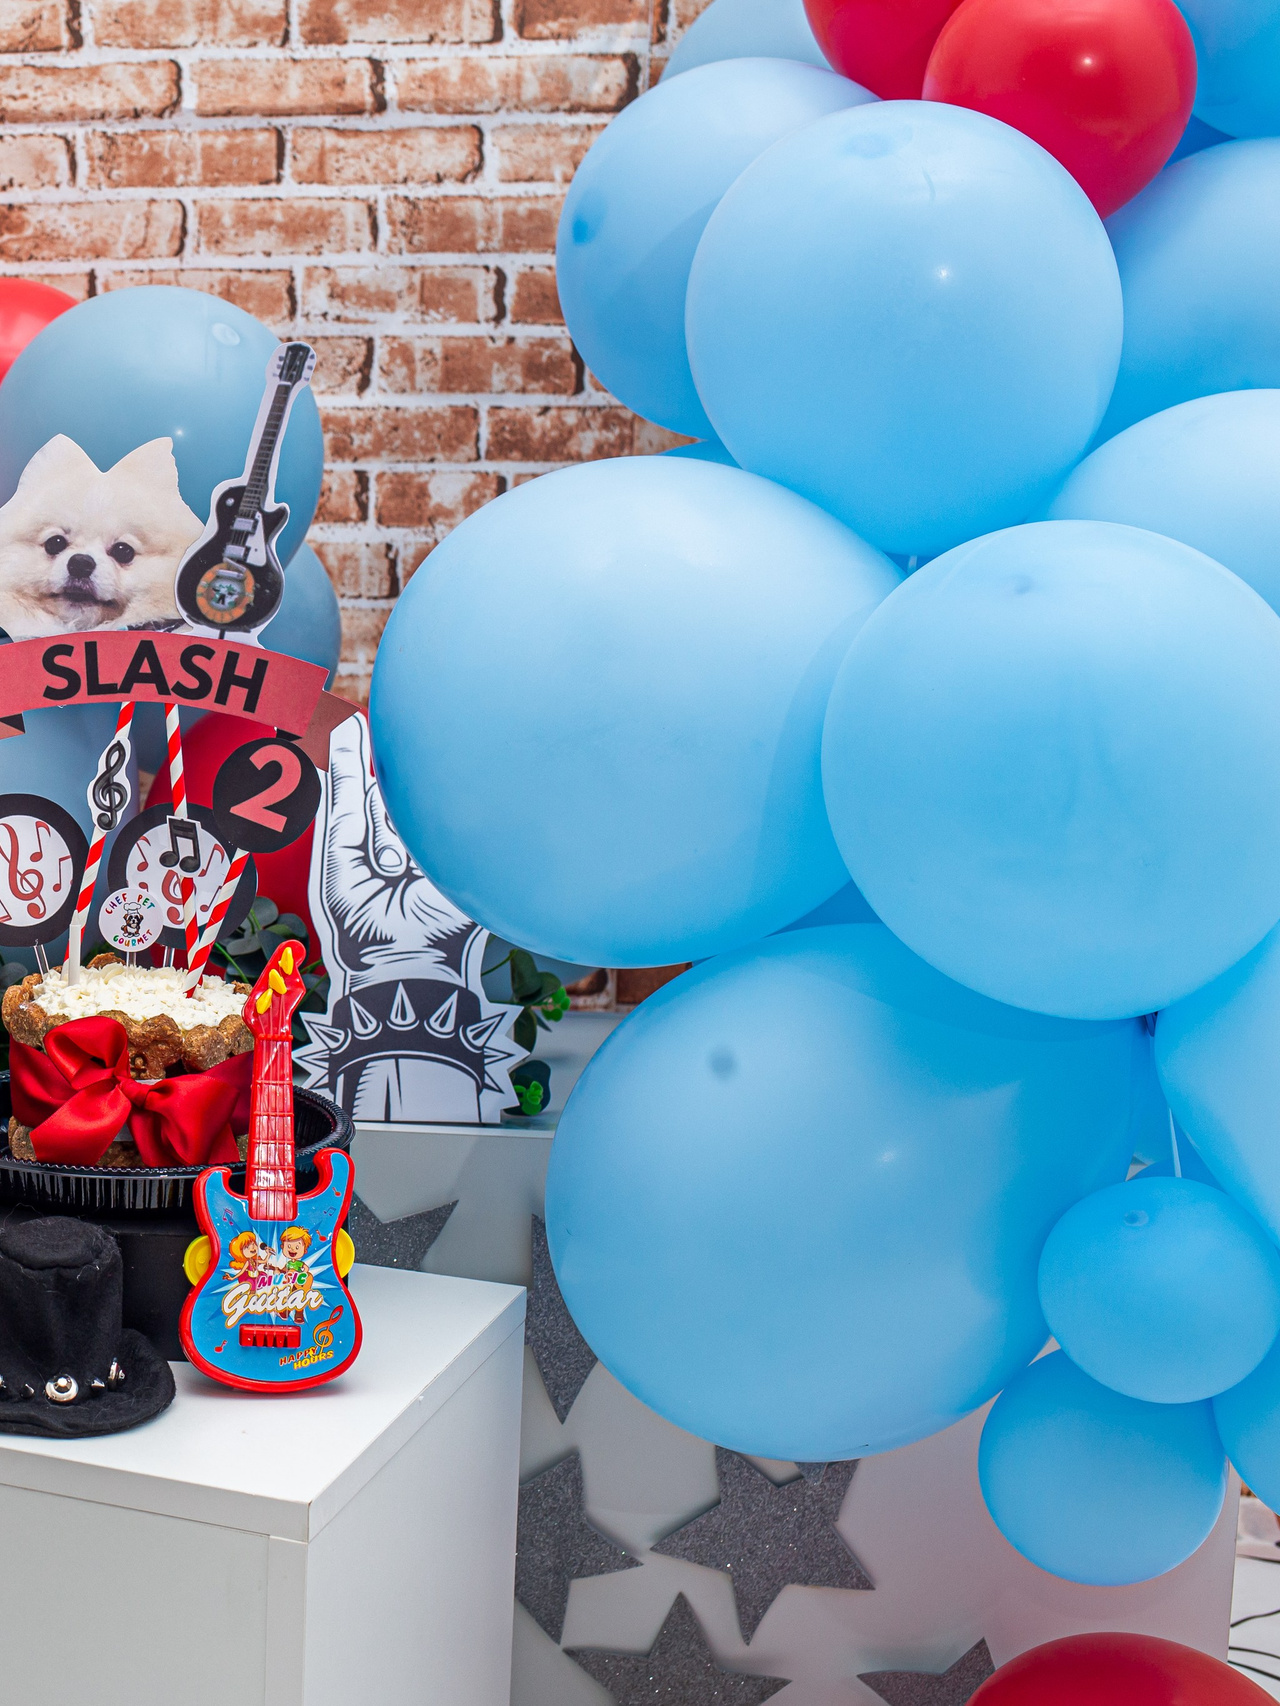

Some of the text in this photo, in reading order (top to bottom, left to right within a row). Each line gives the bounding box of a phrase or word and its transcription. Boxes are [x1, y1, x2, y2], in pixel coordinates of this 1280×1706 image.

[41, 639, 269, 714] SLASH
[229, 744, 302, 833] 2
[105, 893, 155, 914] CHEF PET
[113, 929, 152, 947] GOURMET
[258, 1272, 307, 1290] MUSIC
[223, 1283, 323, 1329] Guitar
[279, 1347, 318, 1366] HAPPY
[293, 1350, 334, 1370] HOURS
